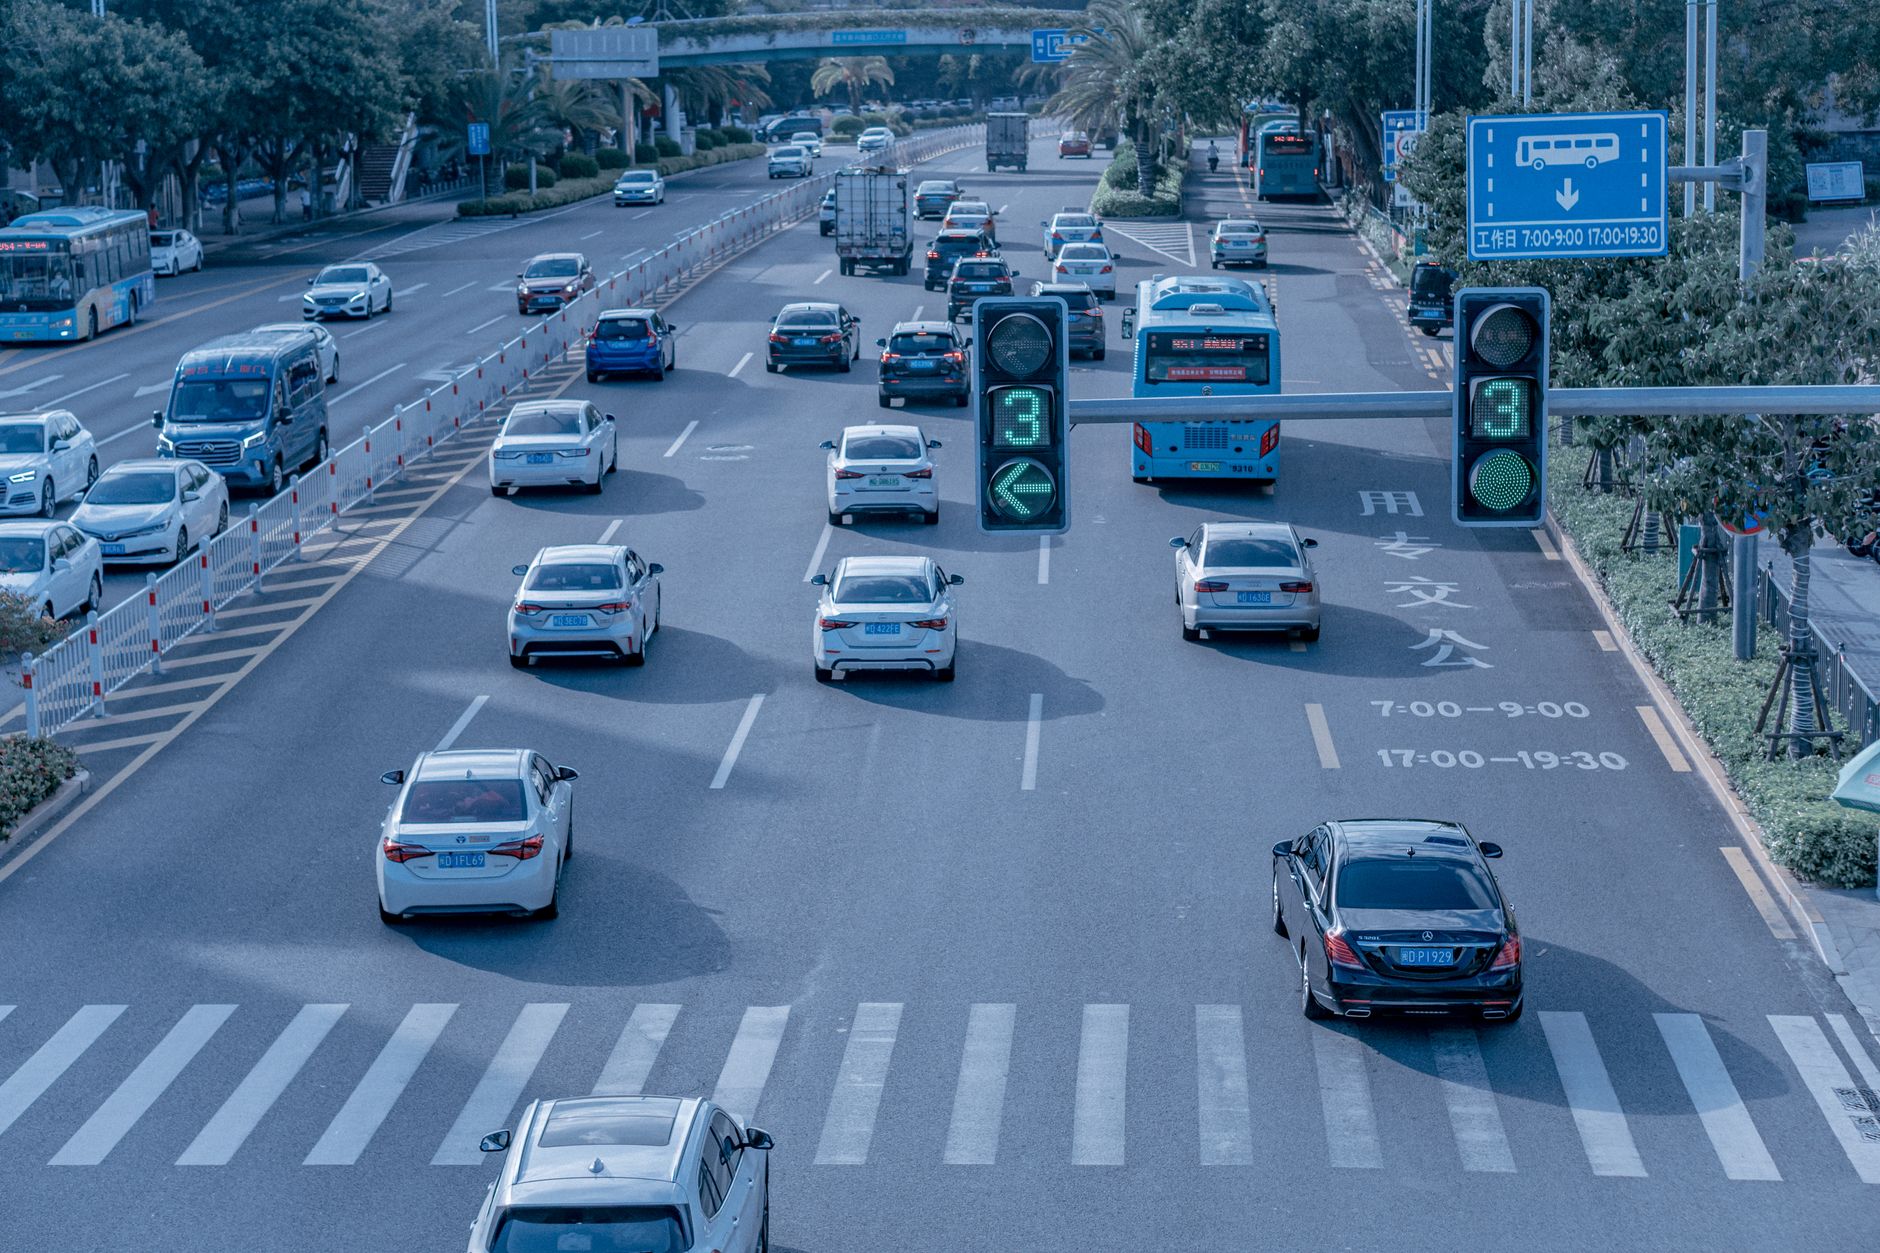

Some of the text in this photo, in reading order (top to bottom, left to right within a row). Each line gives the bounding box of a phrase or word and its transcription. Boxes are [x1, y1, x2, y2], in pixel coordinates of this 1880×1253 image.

[1477, 226, 1658, 250] 工作日 7:00-9:00 17:00-19:30
[1005, 390, 1039, 445] 3
[1485, 381, 1519, 437] 3
